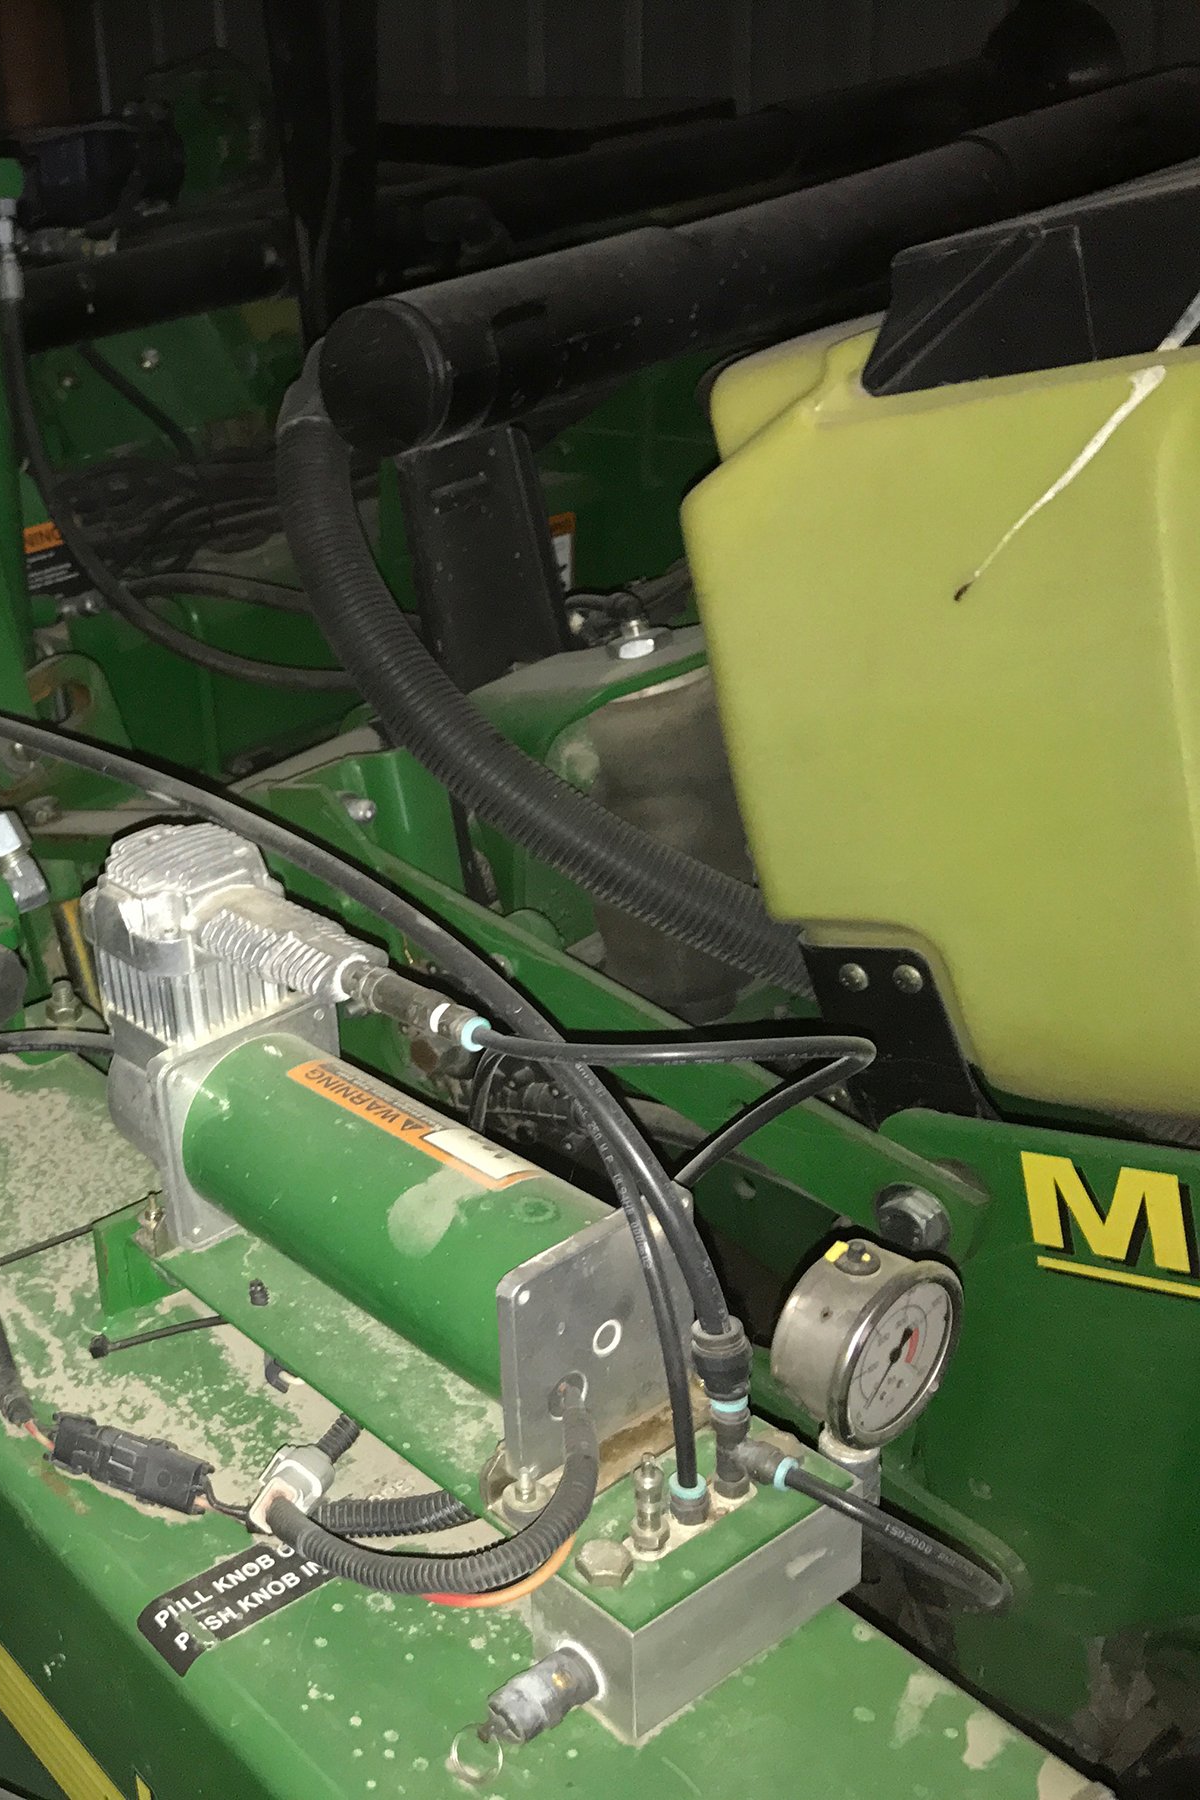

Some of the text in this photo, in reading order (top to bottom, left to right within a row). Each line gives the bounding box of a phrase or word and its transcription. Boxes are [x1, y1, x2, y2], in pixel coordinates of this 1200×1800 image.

[304, 1068, 400, 1123] WARNING
[1020, 1150, 1196, 1275] M
[154, 1589, 214, 1629] PULL
[211, 1554, 276, 1594] KNOB
[174, 1606, 239, 1651] PSH
[236, 1572, 301, 1613] KNOB
